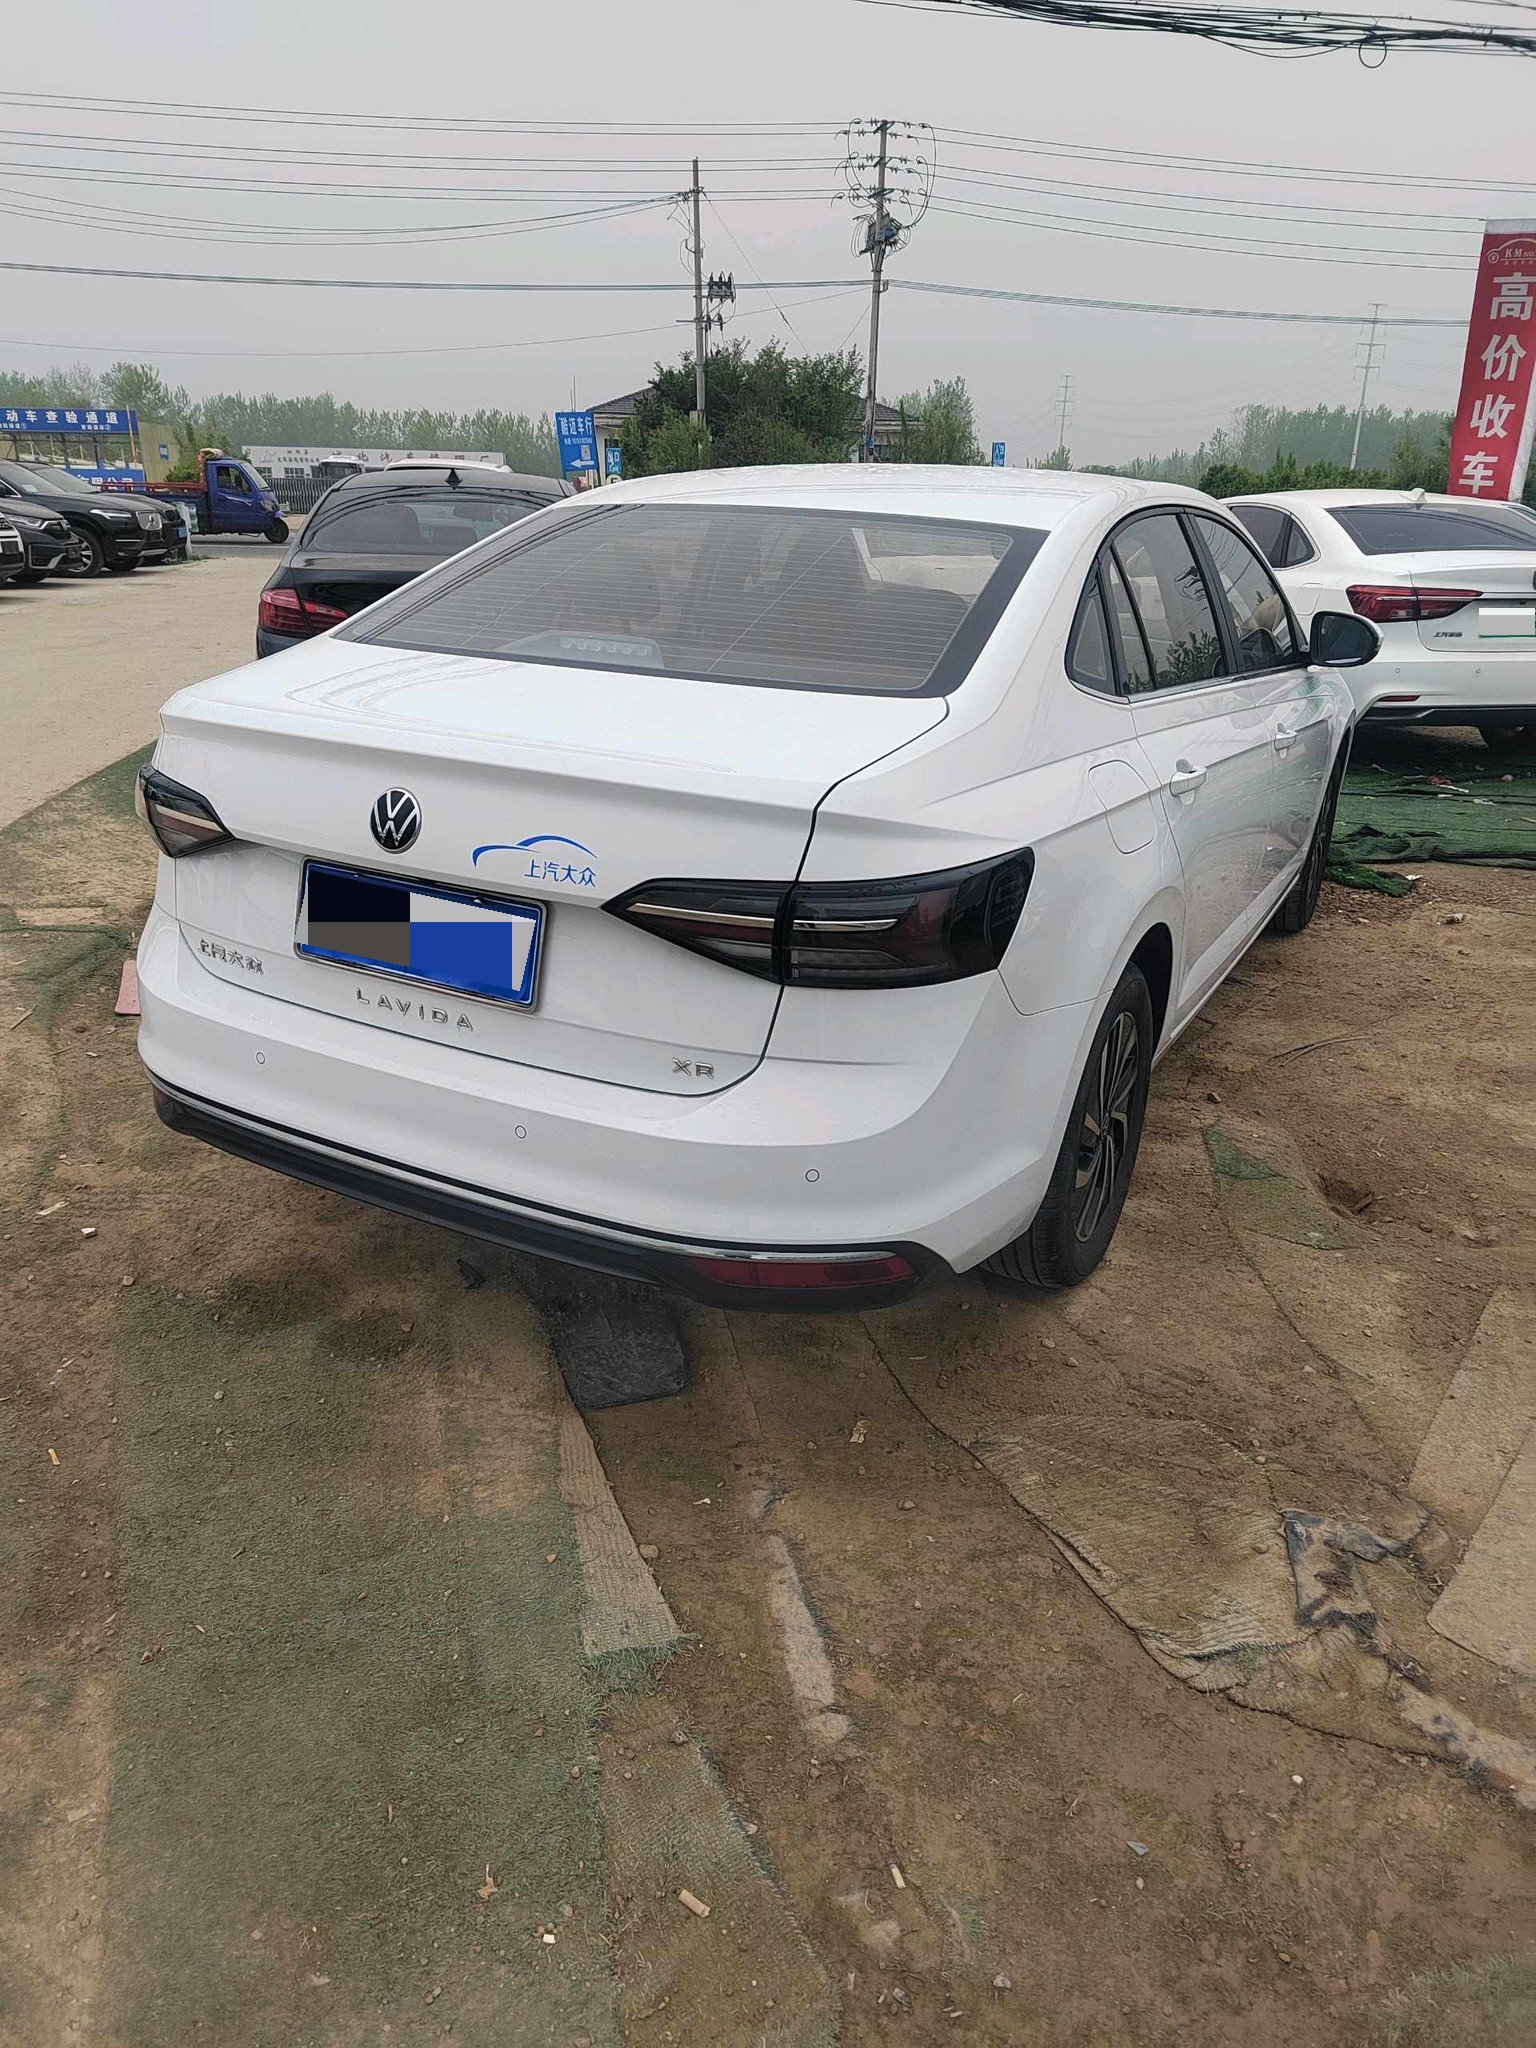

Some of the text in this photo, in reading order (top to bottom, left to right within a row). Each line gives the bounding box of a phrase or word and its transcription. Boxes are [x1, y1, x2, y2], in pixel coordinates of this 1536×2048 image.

[1459, 271, 1536, 494] 高价收车
[5, 409, 119, 424] 动车查验通道
[524, 859, 596, 888] 上汽大众
[198, 938, 264, 974] 上汽大众
[356, 987, 473, 1032] LAVIDA
[672, 1057, 715, 1080] XR
